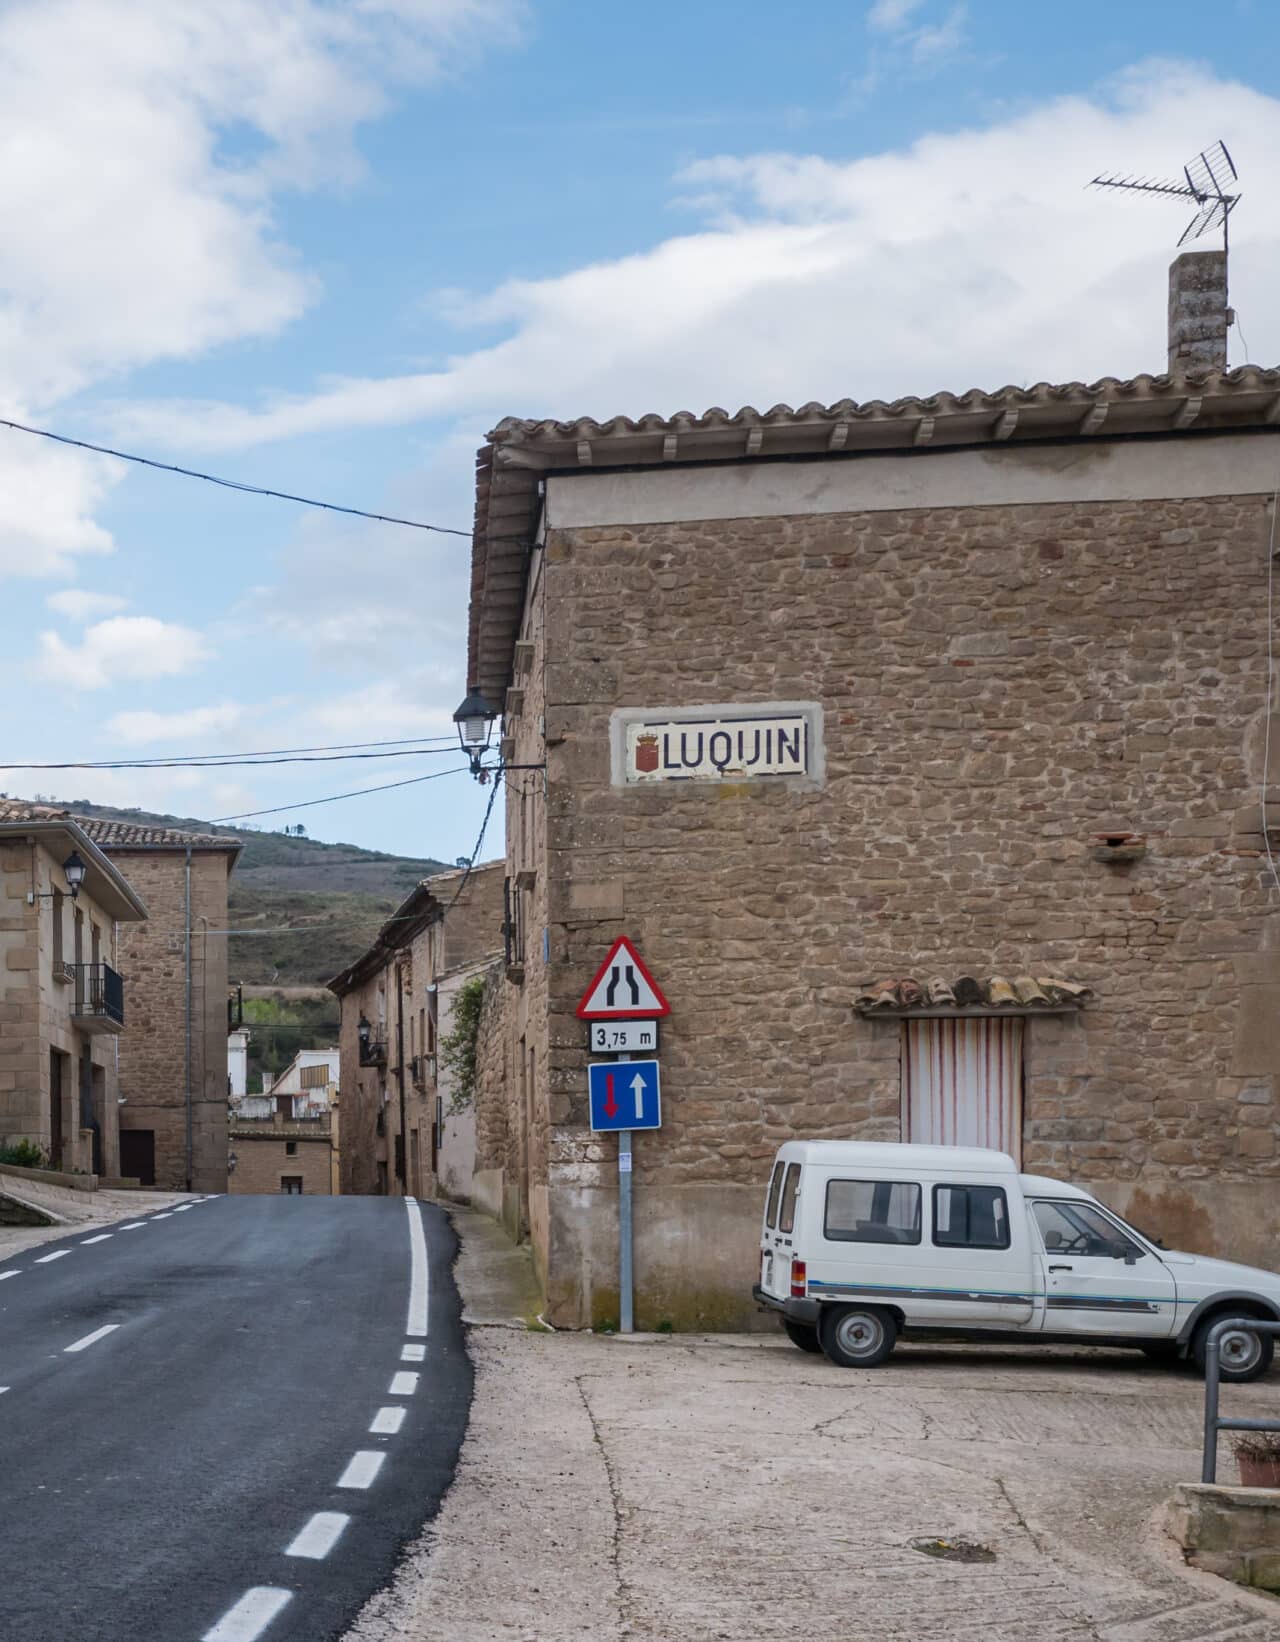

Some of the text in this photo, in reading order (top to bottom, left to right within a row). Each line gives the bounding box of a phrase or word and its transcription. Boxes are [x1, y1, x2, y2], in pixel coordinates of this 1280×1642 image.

[663, 727, 800, 771] LUQUIN
[597, 1028, 651, 1049] 3,75 m
